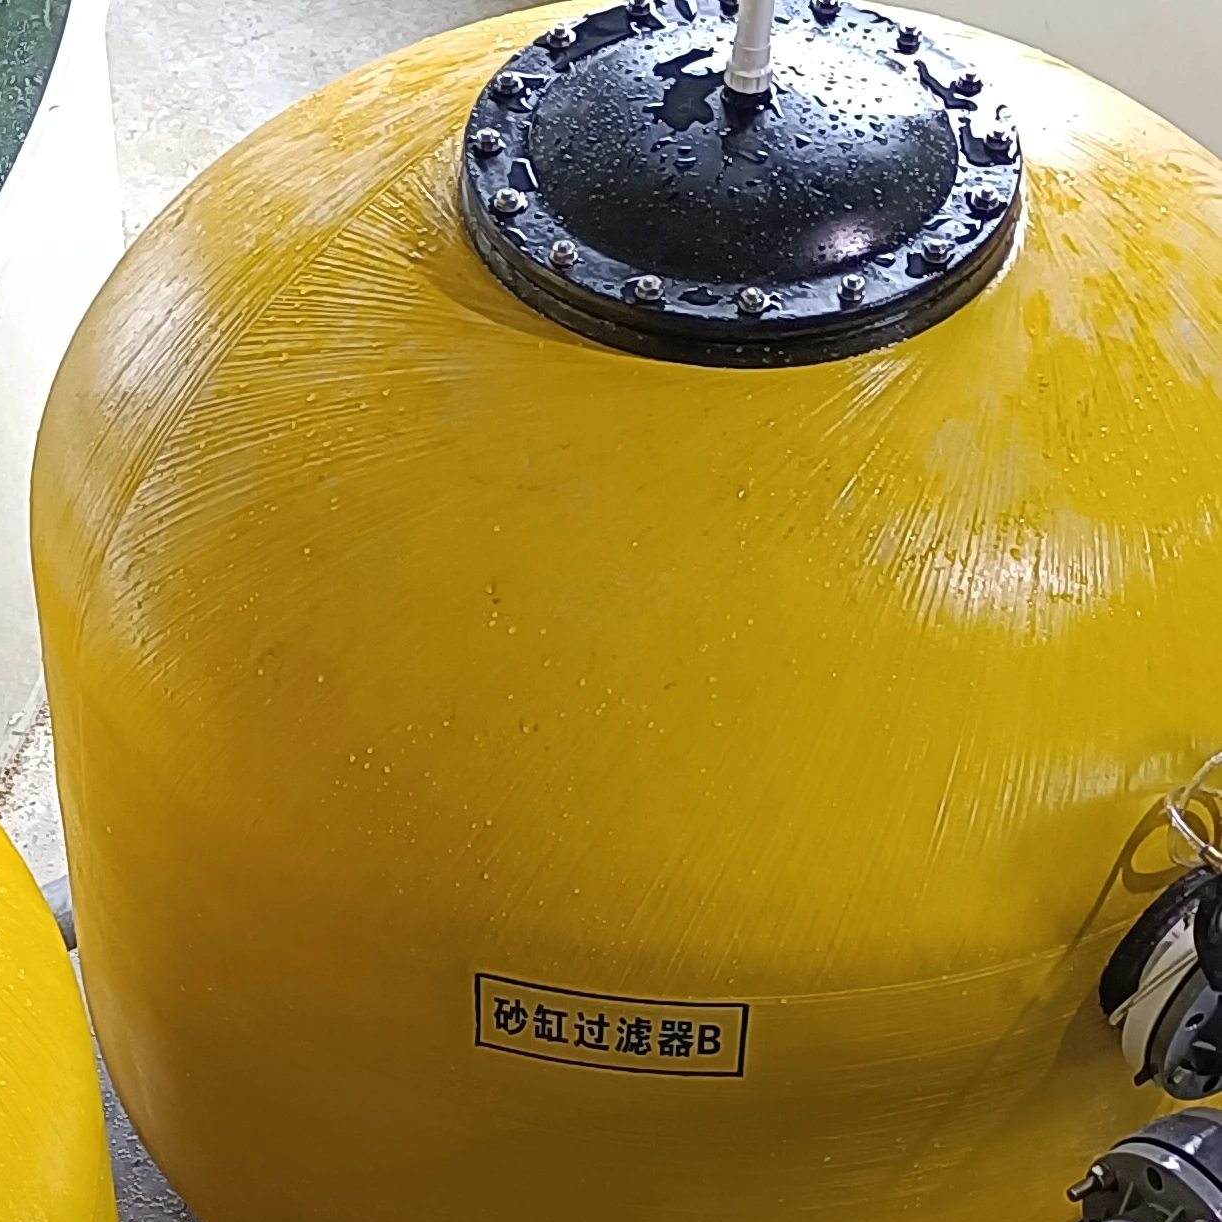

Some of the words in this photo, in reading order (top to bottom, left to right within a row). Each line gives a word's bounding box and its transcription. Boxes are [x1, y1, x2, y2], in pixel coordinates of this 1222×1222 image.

[493, 997, 721, 1057] 砂缸过滤器B
